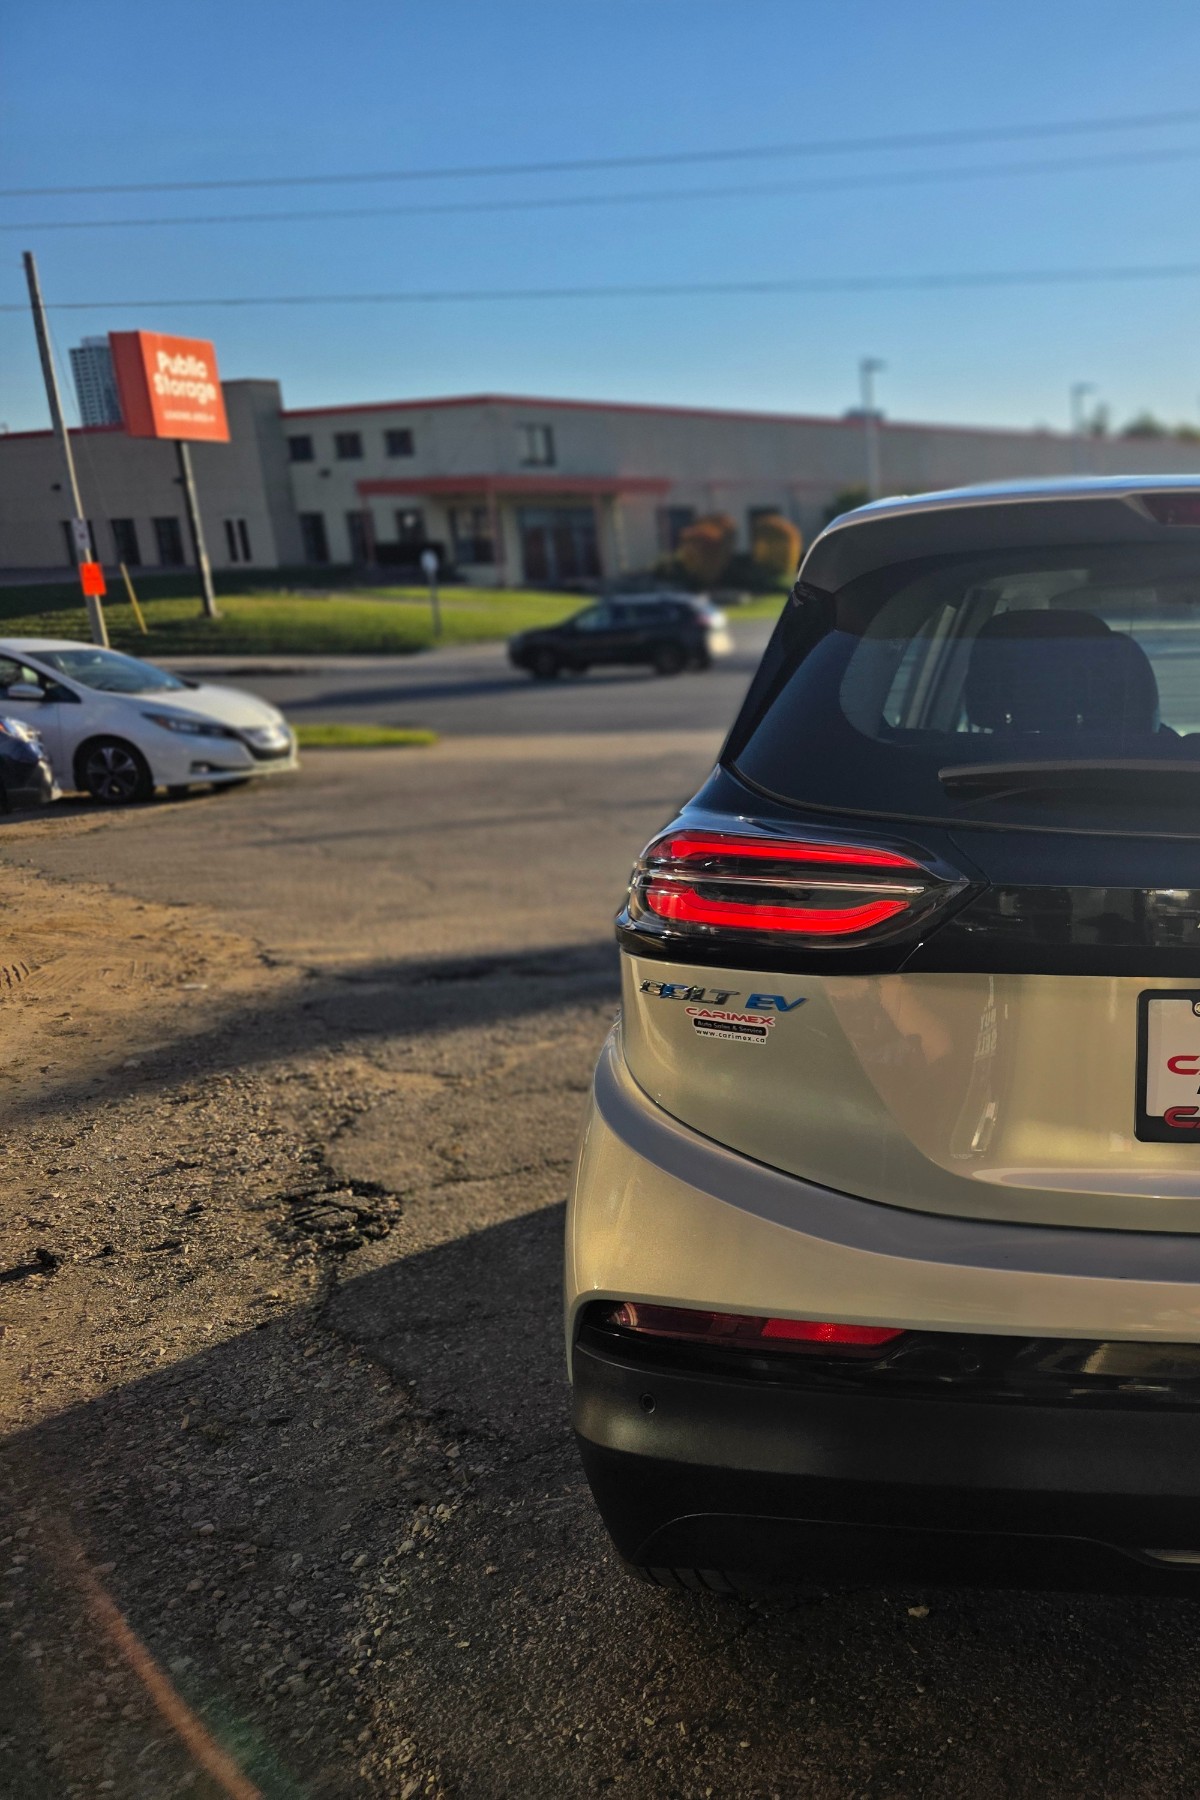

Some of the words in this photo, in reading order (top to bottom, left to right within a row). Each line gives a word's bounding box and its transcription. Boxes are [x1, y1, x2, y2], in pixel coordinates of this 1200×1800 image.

[157, 351, 208, 378] Public
[153, 372, 216, 405] Storage
[745, 993, 808, 1013] EV
[686, 1007, 775, 1026] CARIMEX
[696, 1029, 765, 1043] www.carimex.ca
[697, 1020, 712, 1028] Auto
[739, 1026, 763, 1034] Service
